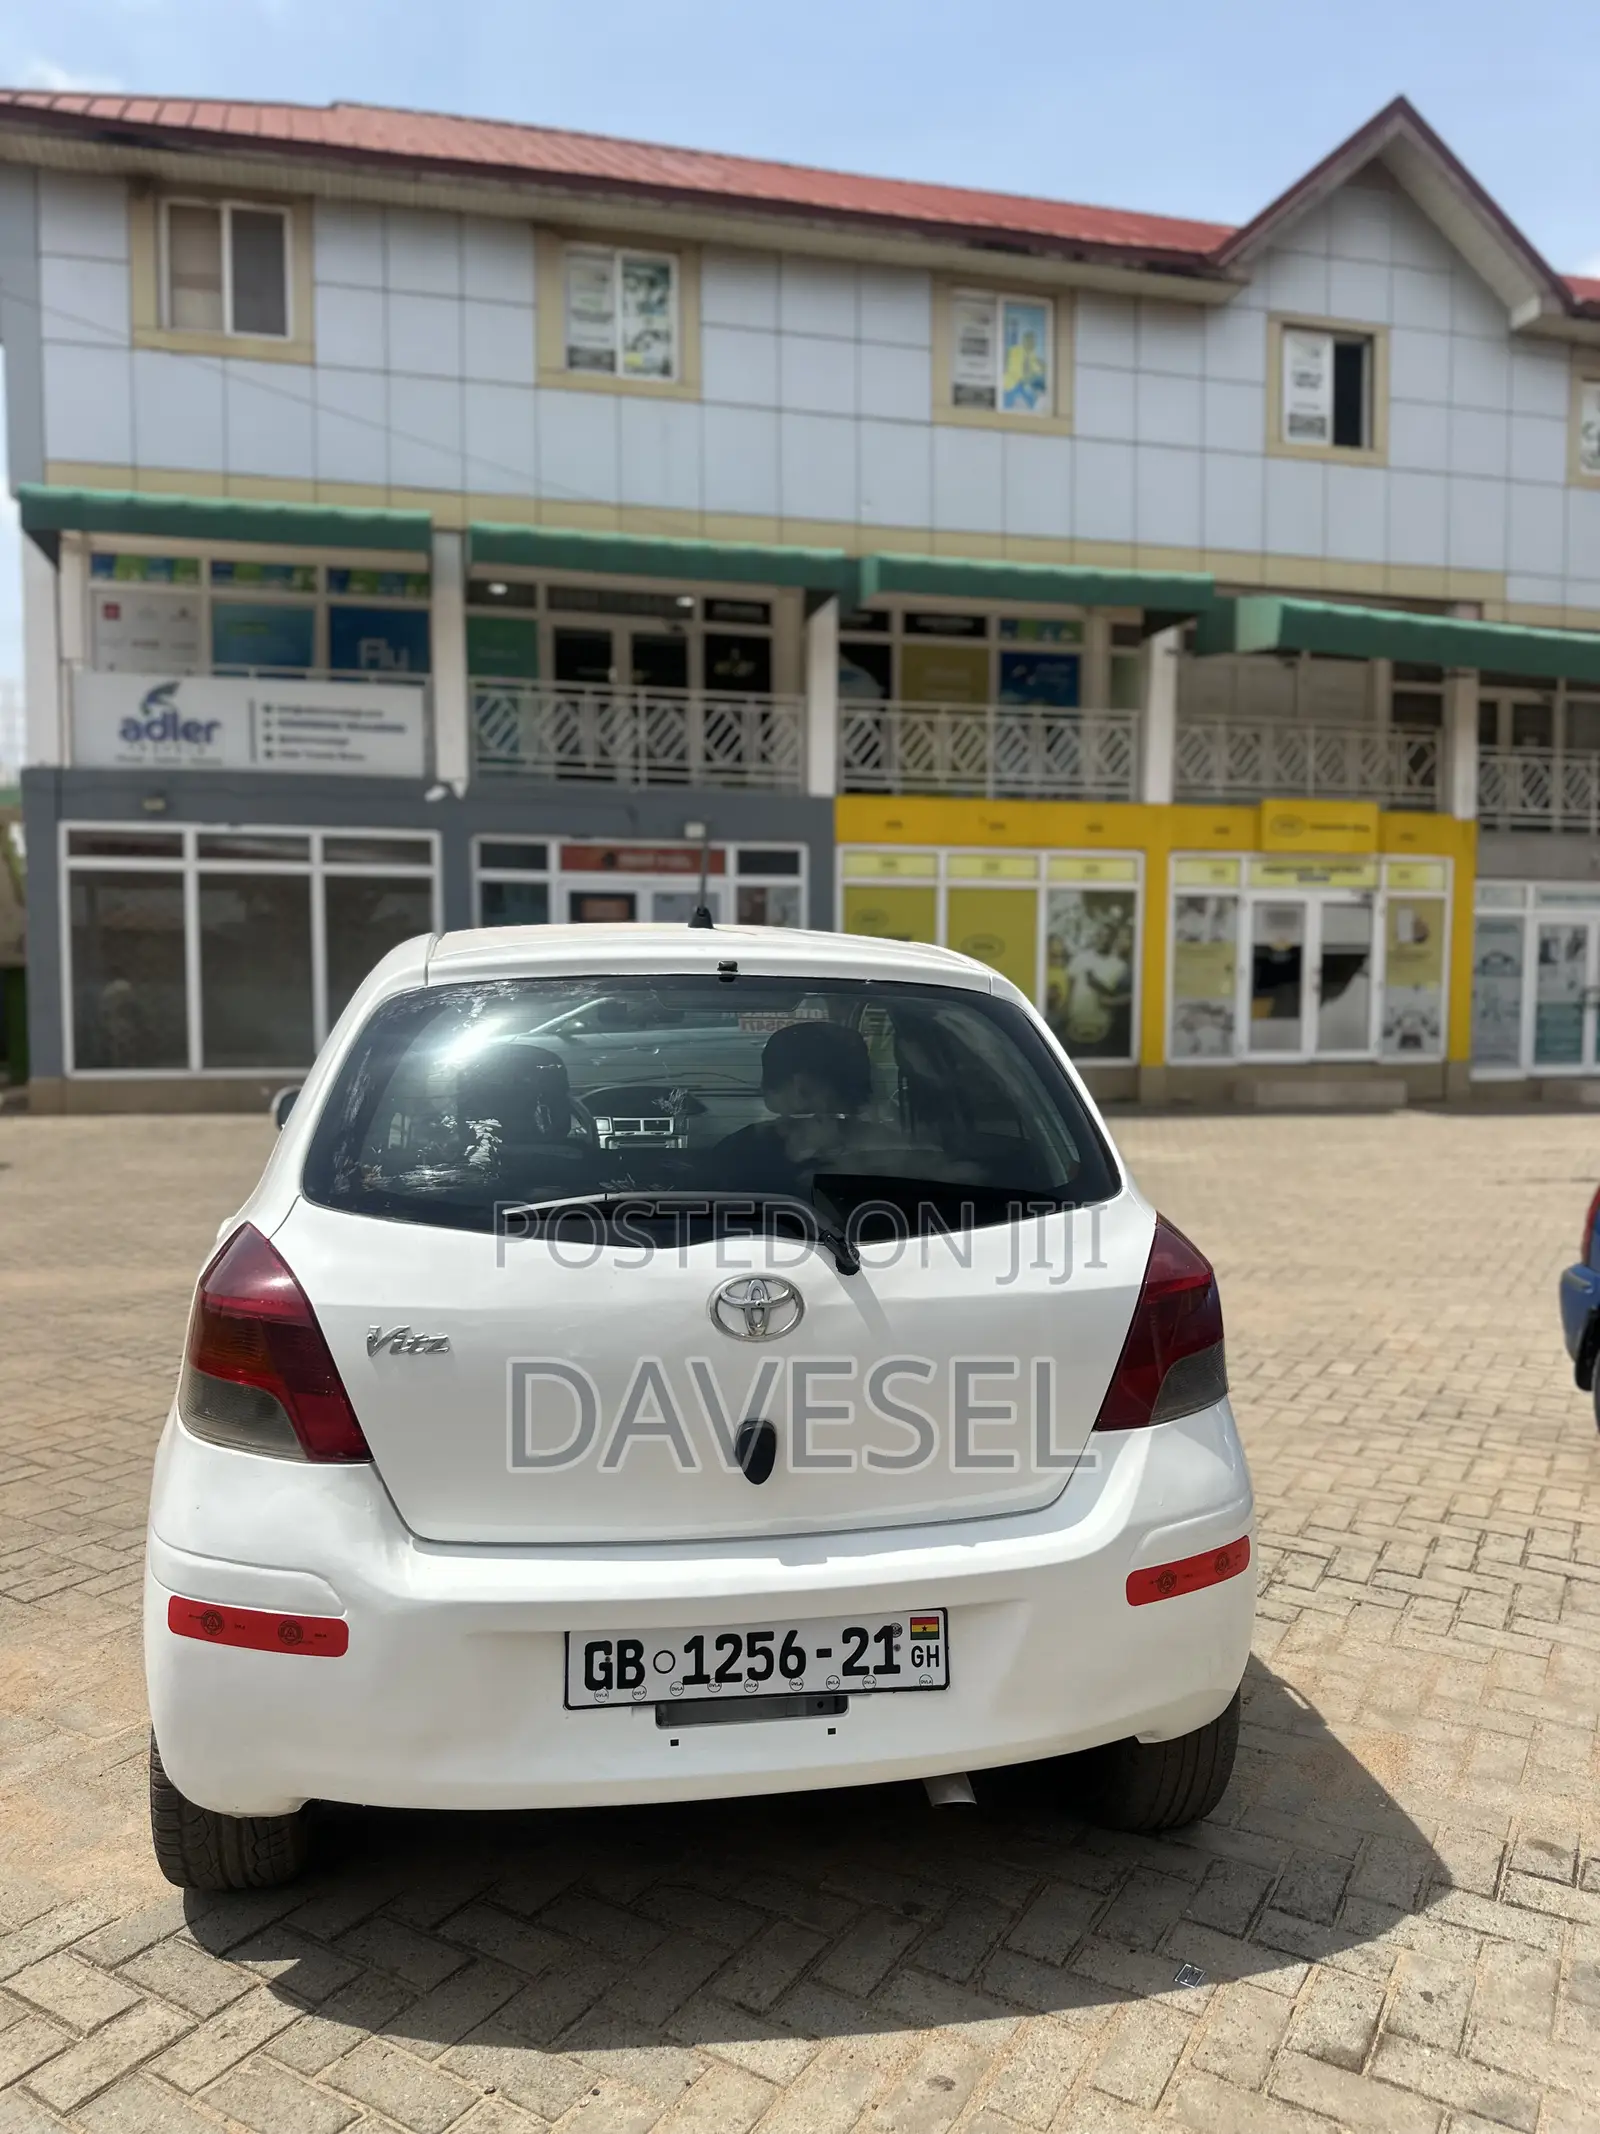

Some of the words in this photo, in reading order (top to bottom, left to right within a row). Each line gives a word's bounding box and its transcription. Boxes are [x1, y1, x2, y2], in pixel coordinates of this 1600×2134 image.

[119, 711, 221, 743] adler
[367, 1325, 449, 1357] Vitz
[584, 1639, 646, 1692] GB
[911, 1645, 940, 1669] GH
